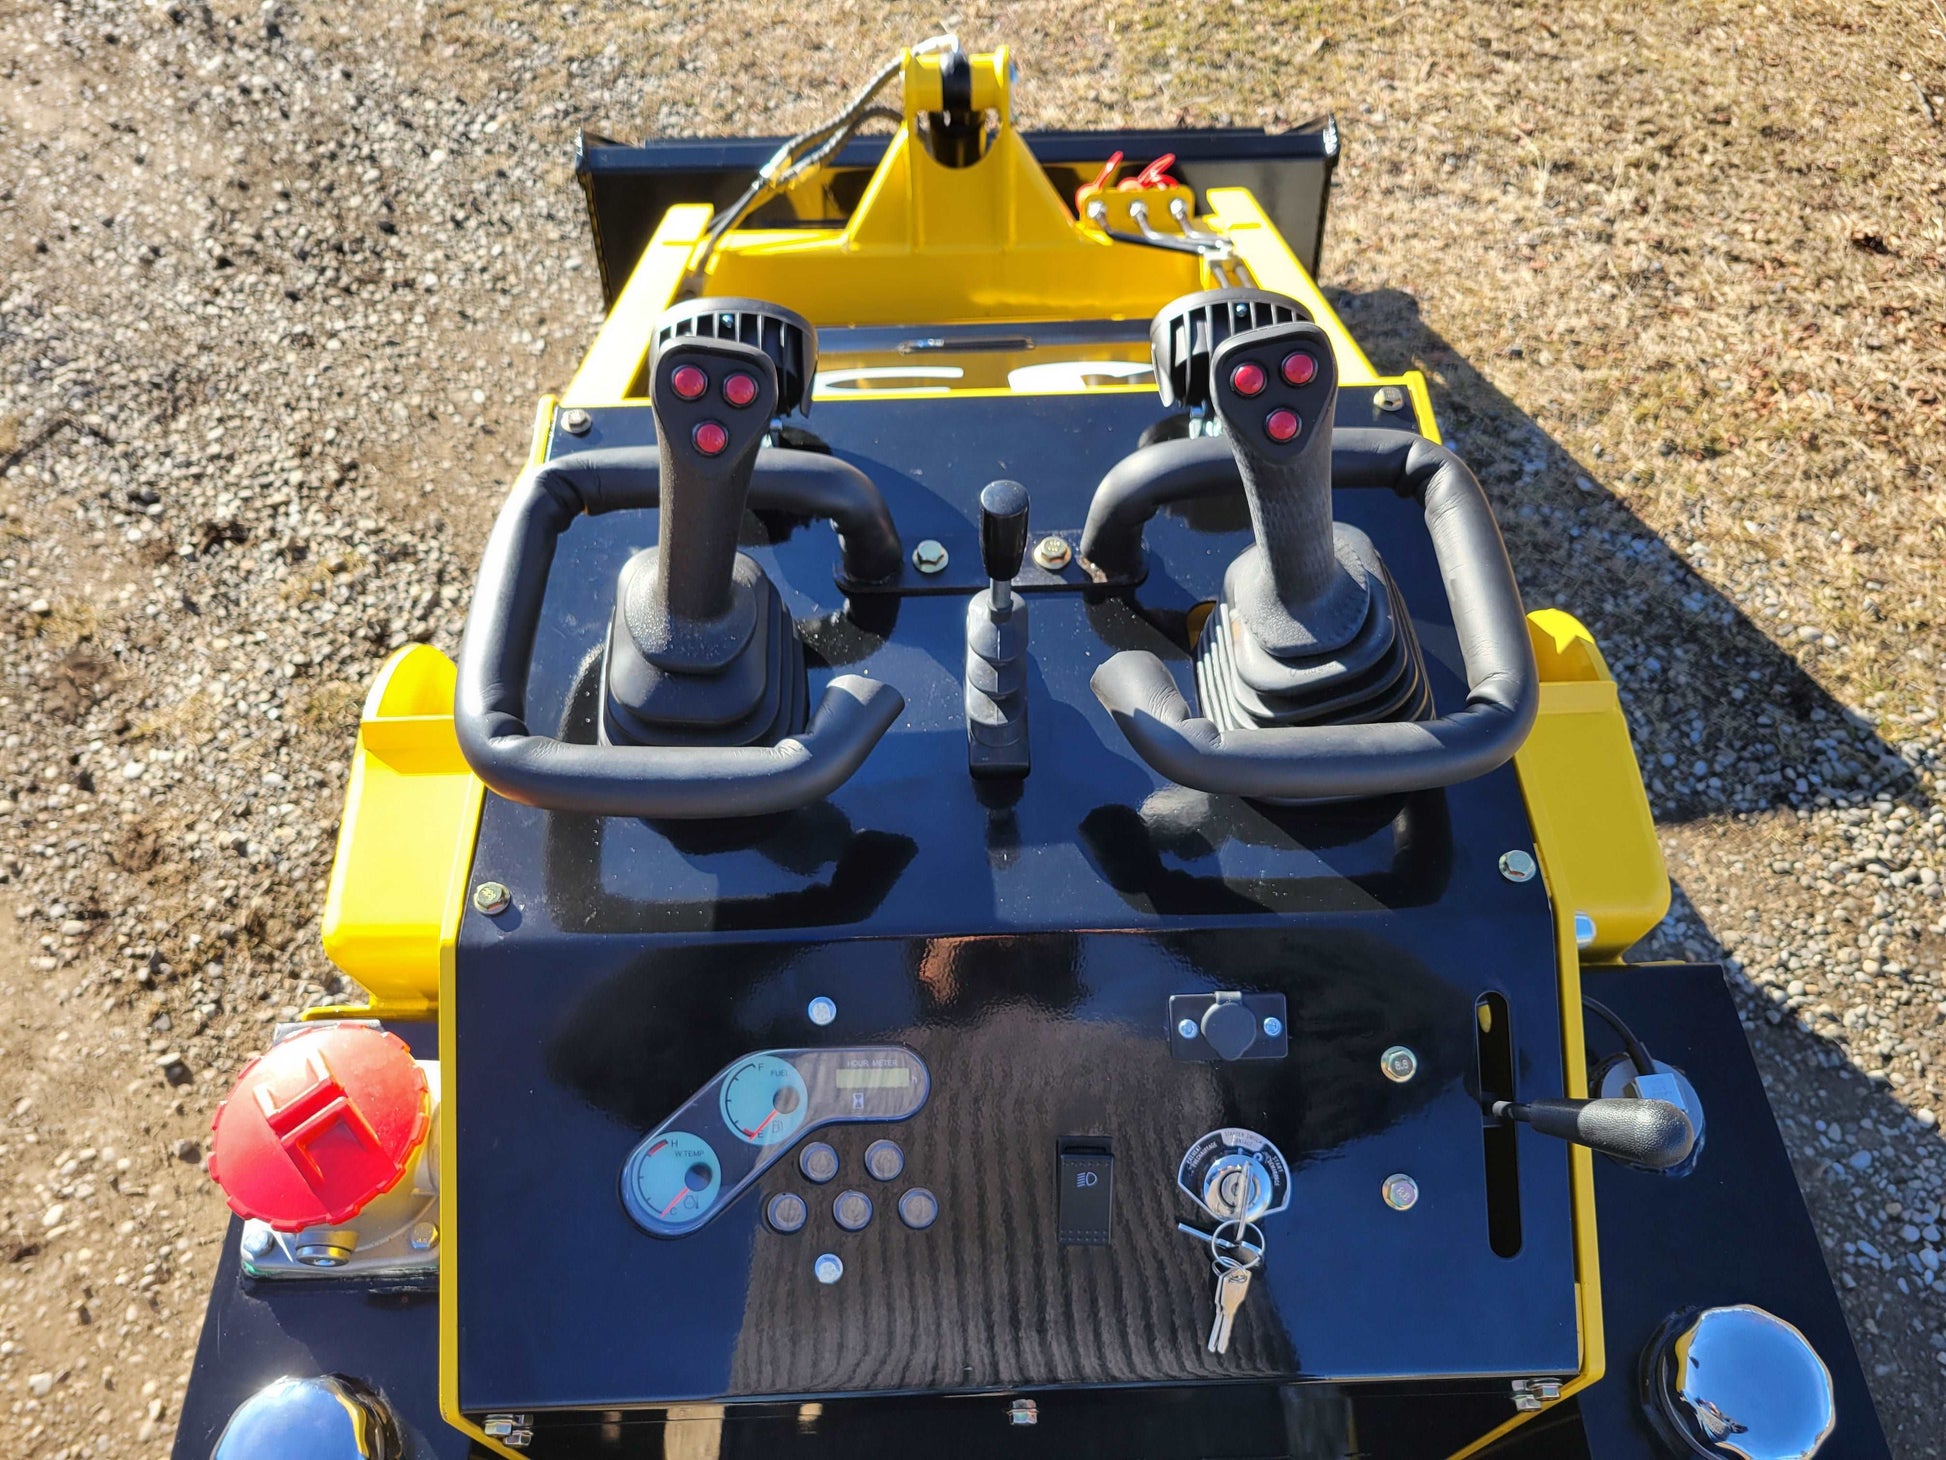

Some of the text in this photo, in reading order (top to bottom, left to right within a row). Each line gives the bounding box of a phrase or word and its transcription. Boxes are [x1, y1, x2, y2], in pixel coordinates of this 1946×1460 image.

[758, 1063, 765, 1071] F
[847, 1059, 897, 1067] HOUR METER
[770, 1069, 790, 1077] FUEL
[671, 1140, 679, 1148] H
[1271, 1155, 1284, 1173] START
[670, 1206, 677, 1215] C
